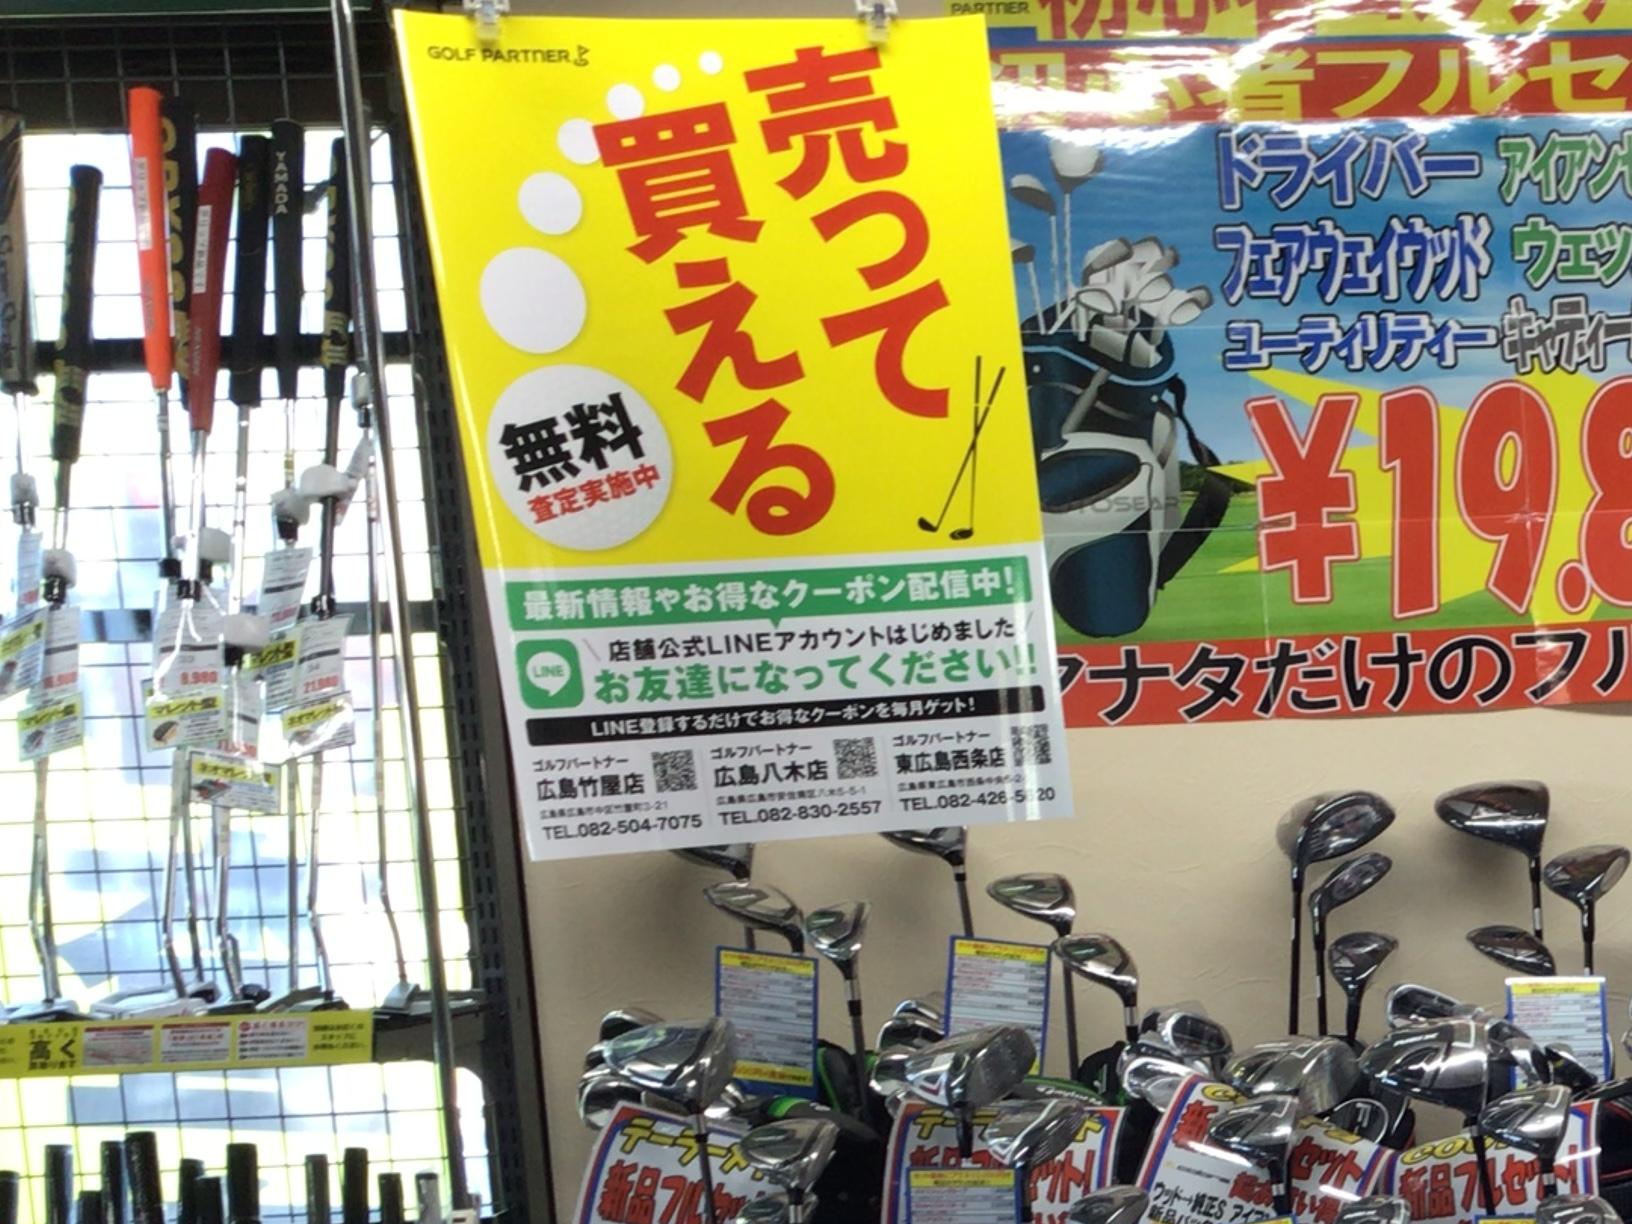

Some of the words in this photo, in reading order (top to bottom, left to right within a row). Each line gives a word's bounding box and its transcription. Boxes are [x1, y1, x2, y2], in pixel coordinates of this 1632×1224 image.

[428, 45, 475, 62] GOLF
[273, 150, 289, 215] YAMADA
[1216, 130, 1481, 211] ドライバー
[744, 45, 950, 418] 売って
[1213, 212, 1493, 304] フェアウェイウッド
[593, 102, 836, 536] 買える
[1222, 311, 1499, 371] ユーティリティー
[499, 392, 645, 492] 無料
[528, 463, 661, 524] 査定実施中
[522, 566, 1017, 622] 最新情報やお得なクーポン配信中!
[608, 616, 1017, 664] 店舗公式LINEアカウントはじめました
[533, 665, 564, 678] LINE
[711, 742, 812, 760] ゴルフパートナー
[892, 731, 991, 748] ゴルフパートナー
[532, 755, 629, 772] ゴルフパートナー
[714, 760, 829, 788] 広島八木店
[894, 747, 1006, 775] 東広島西条店
[537, 773, 646, 802] 広島竹屋店
[543, 814, 703, 841] TEL.082-504-7075
[718, 800, 882, 826] TEL.082-830-2557
